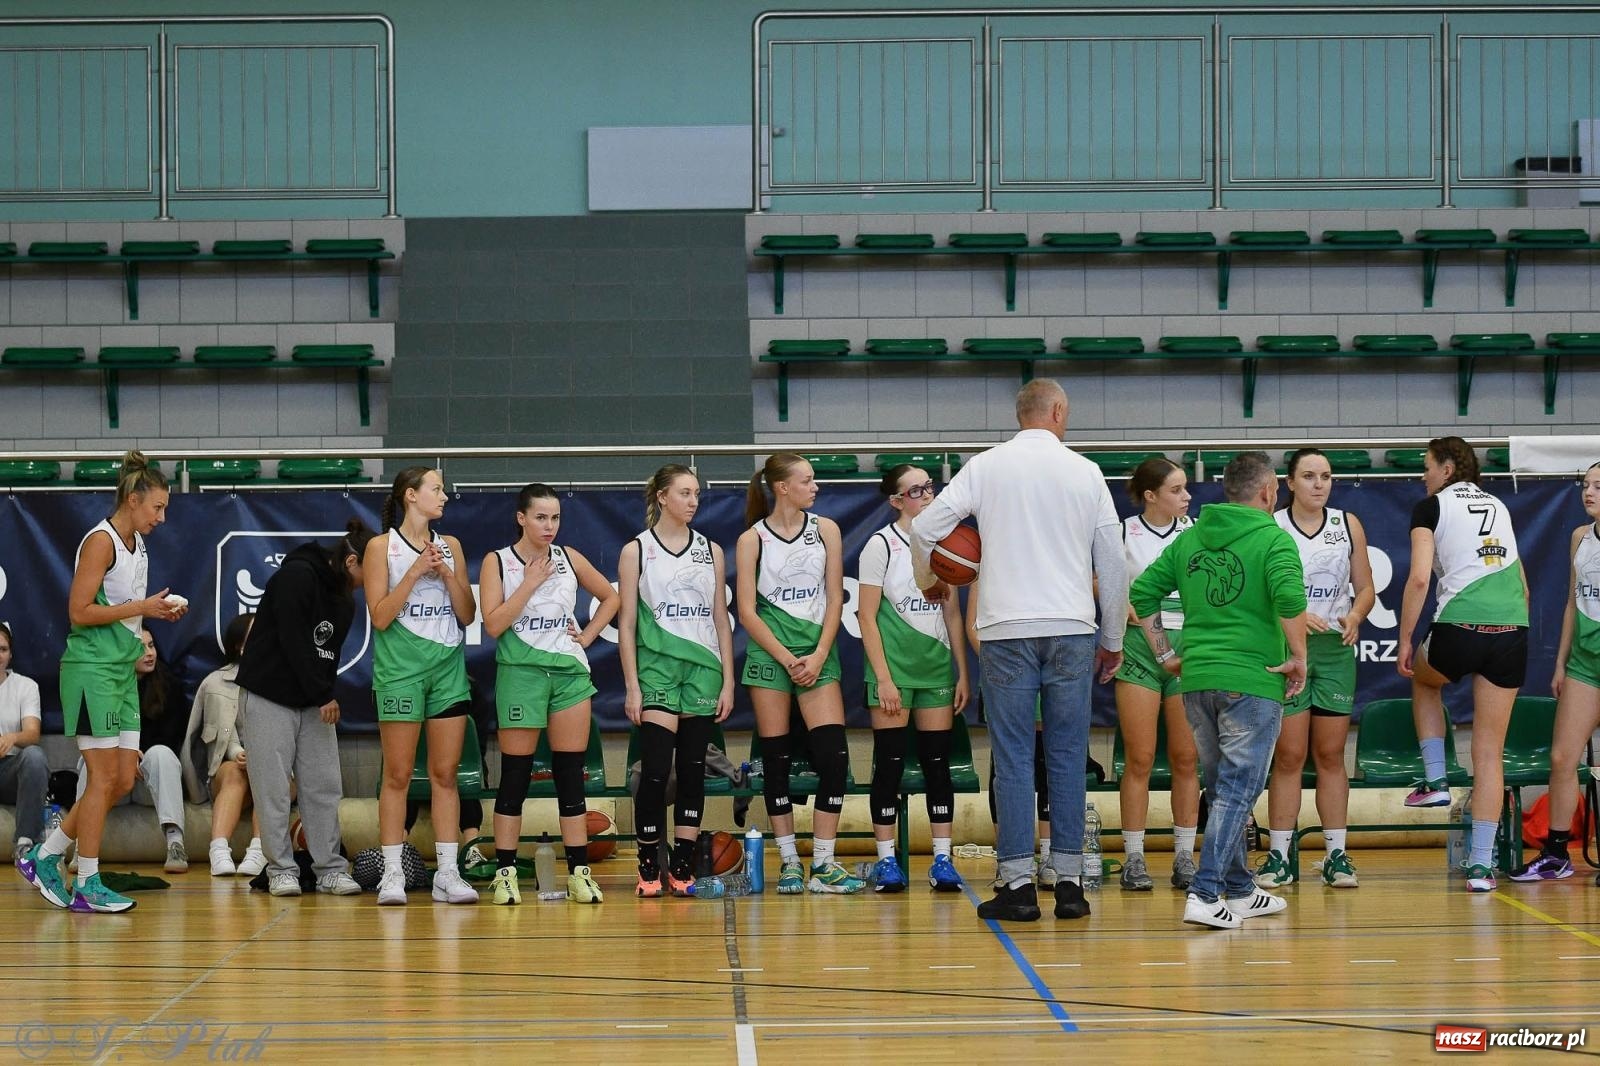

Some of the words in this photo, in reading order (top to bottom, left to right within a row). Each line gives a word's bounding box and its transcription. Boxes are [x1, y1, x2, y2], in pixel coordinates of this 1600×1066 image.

[1467, 503, 1497, 537] 7
[1323, 530, 1347, 545] 24
[691, 548, 714, 565] 28
[782, 584, 820, 601] Clavi
[666, 603, 711, 617] Clavis
[1354, 640, 1398, 662] RZ
[747, 662, 777, 682] 30
[383, 697, 413, 715] 26
[508, 704, 524, 721] 8
[106, 711, 121, 730] 14
